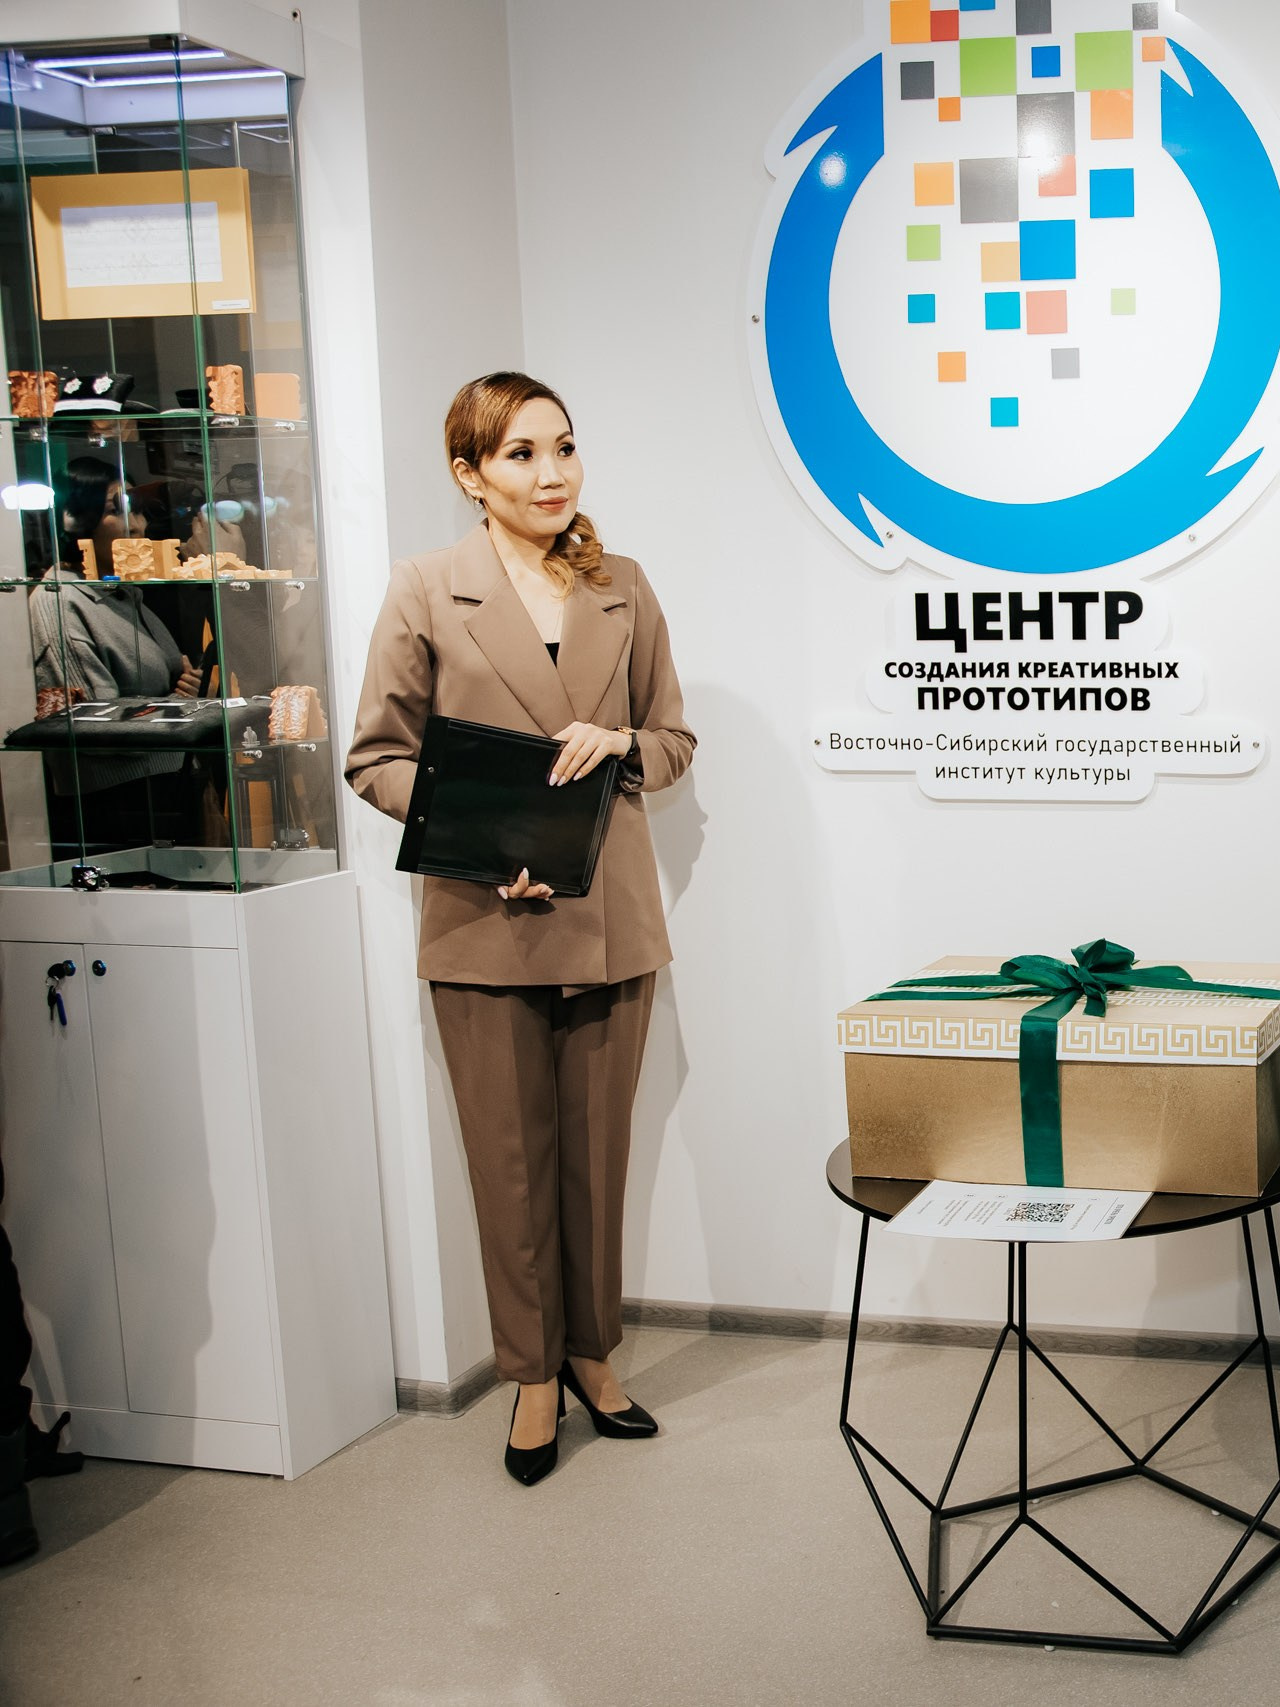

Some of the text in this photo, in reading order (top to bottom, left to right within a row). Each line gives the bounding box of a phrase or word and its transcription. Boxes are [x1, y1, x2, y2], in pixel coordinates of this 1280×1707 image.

[914, 590, 1144, 654] ЦЕНТР
[884, 661, 1180, 683] СОЗДАНИЯ КРЕАТИВНЫХ
[917, 686, 1152, 712] ПРОТОТИПОВ
[829, 732, 1242, 758] Восточно-Сибирский государственный
[935, 765, 1131, 786] институт культуры
